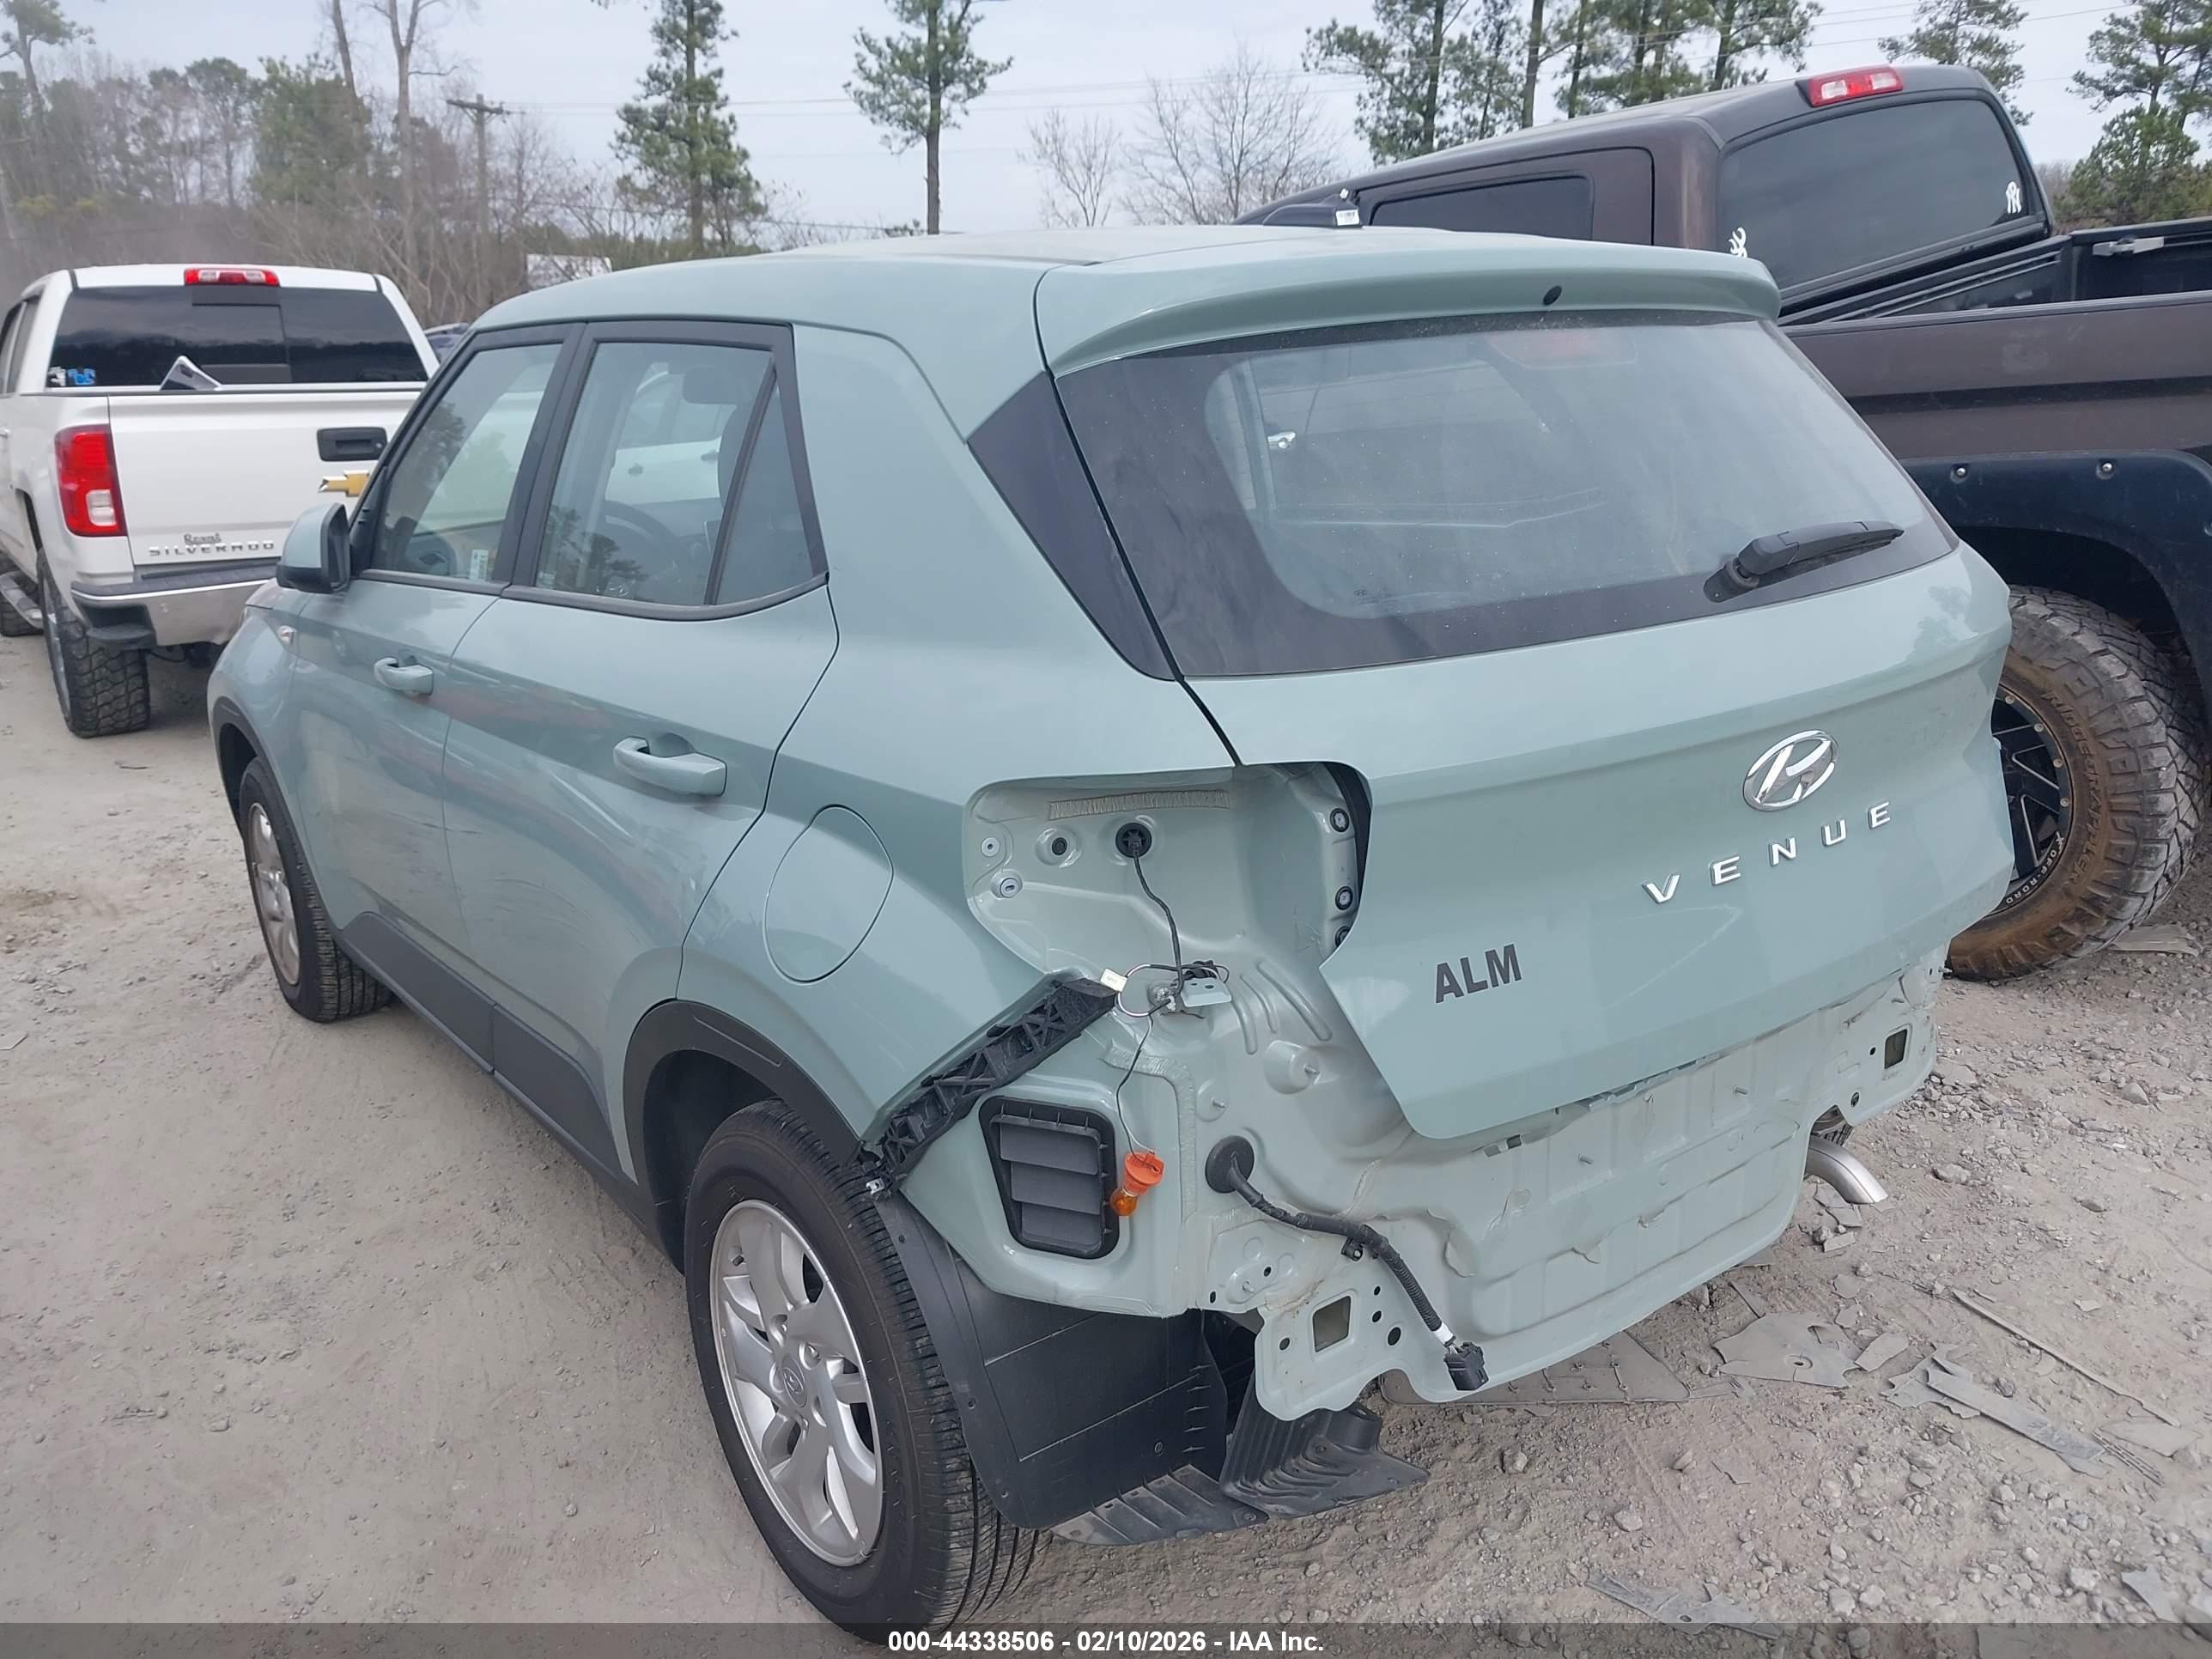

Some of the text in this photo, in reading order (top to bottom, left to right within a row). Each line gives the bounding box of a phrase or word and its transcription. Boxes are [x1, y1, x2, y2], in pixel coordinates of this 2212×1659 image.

[149, 540, 275, 556] SILVERADO
[2040, 691, 2103, 884] RIDGE GRAPPLER
[1642, 801, 1892, 905] VENUE
[2005, 849, 2057, 904] OFF-ROAD
[1435, 943, 1522, 1004] ALM
